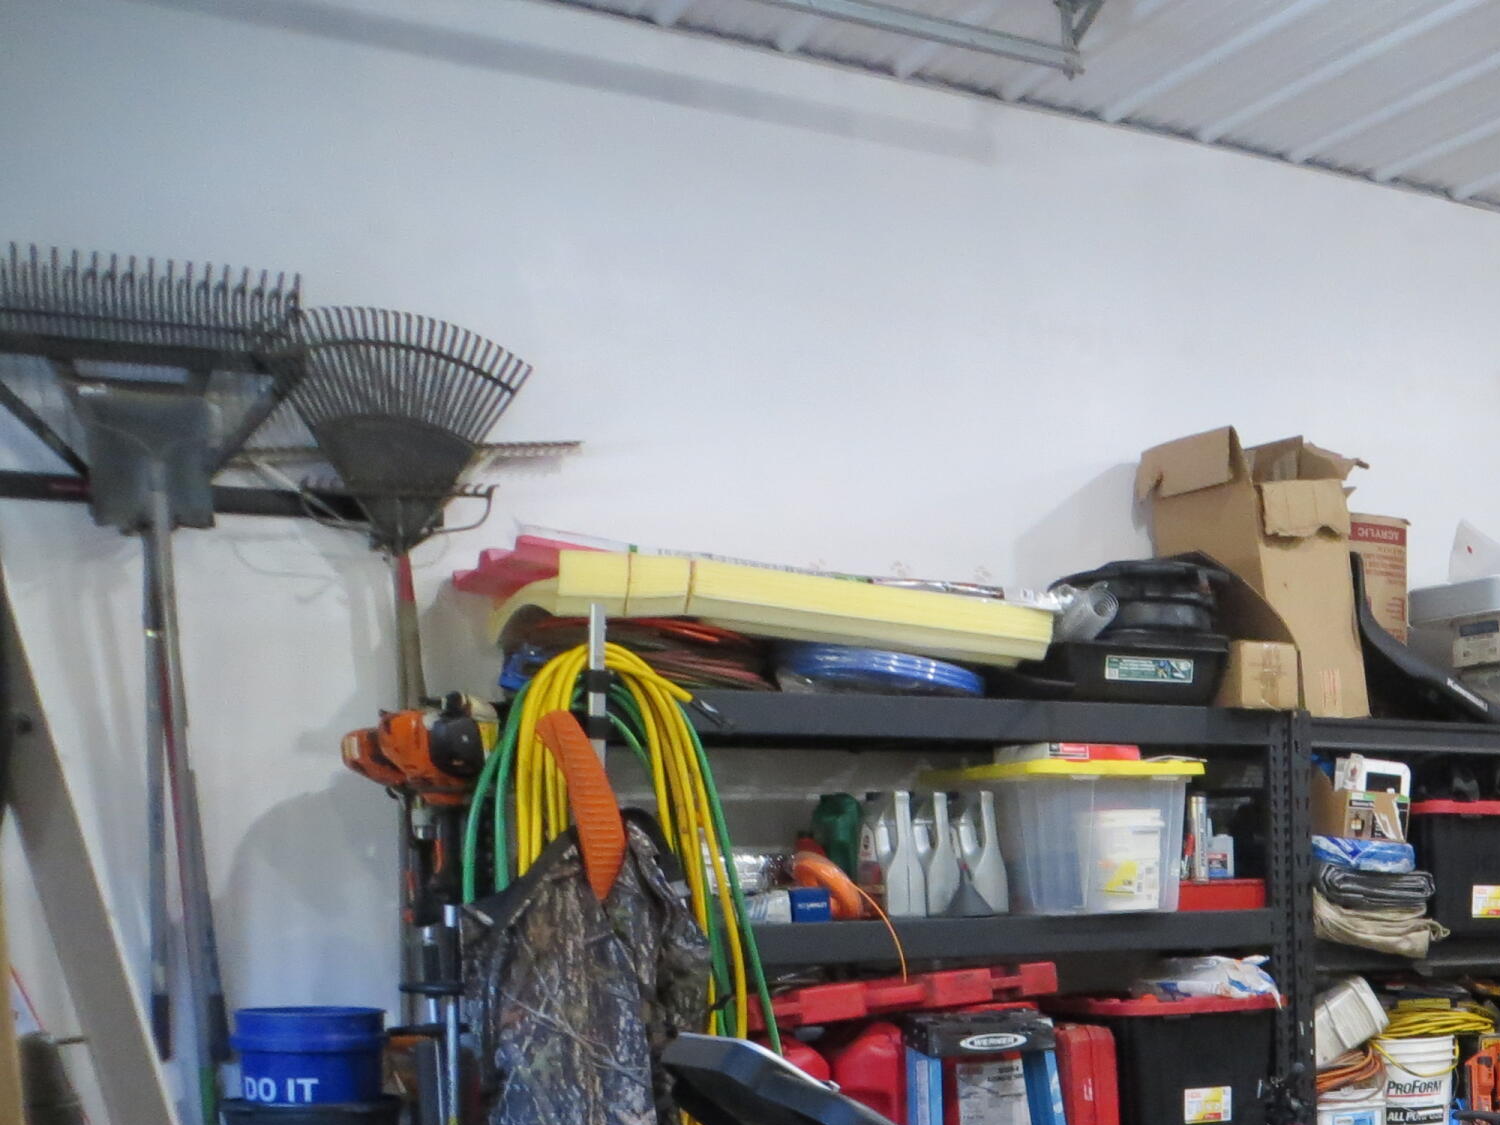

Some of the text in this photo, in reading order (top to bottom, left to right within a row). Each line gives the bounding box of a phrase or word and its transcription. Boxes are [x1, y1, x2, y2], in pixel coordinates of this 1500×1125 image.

[1357, 527, 1400, 541] ACRYLIC
[974, 1036, 1014, 1047] WERNER
[244, 1076, 319, 1103] DO IT
[1387, 1111, 1404, 1122] ALL
